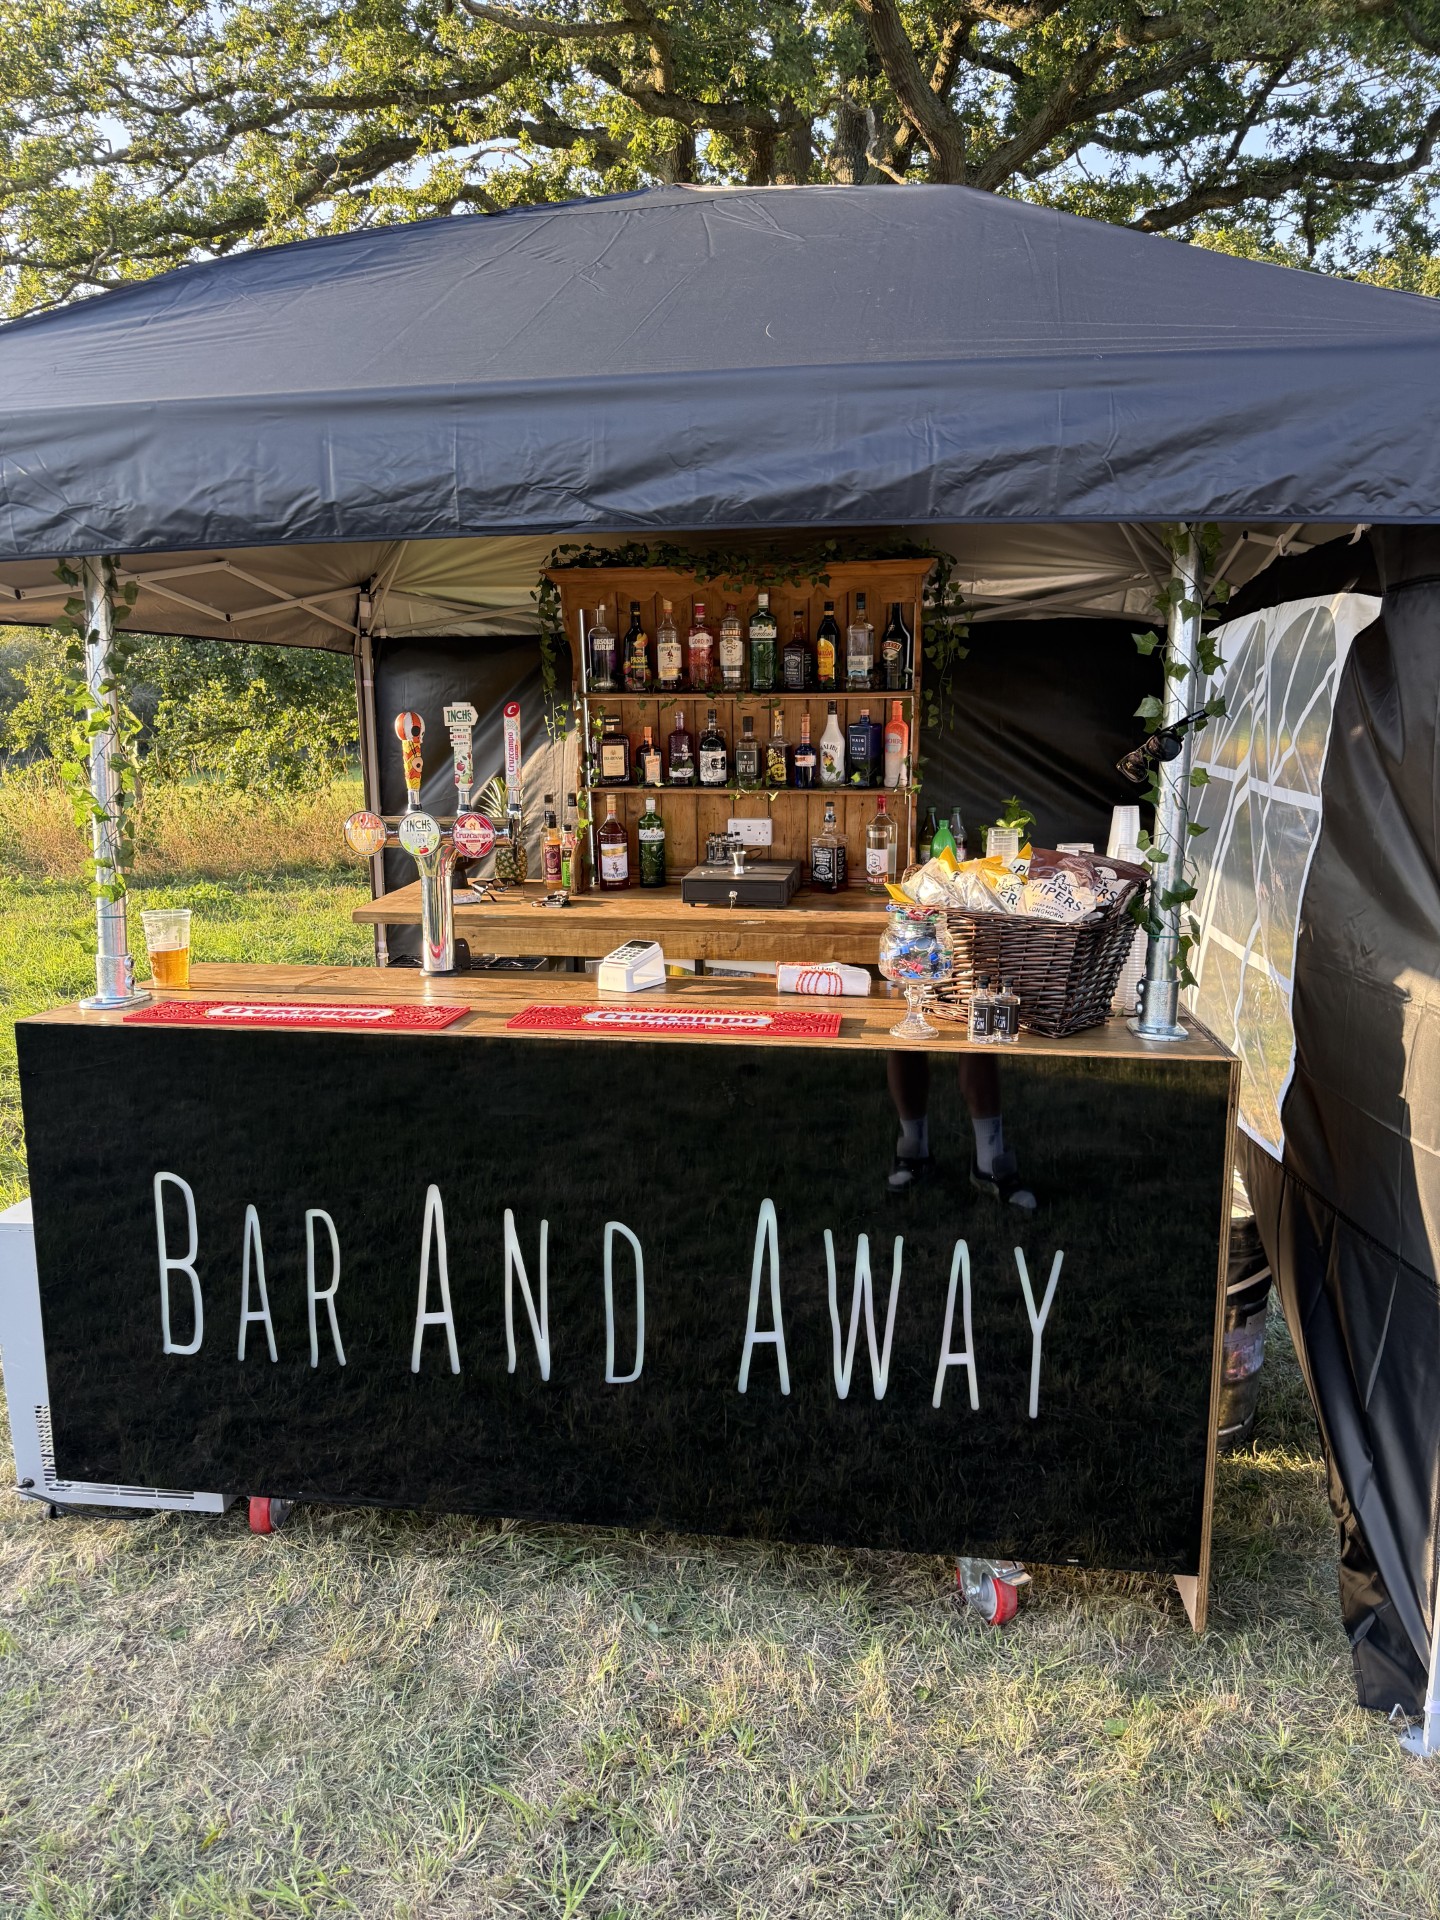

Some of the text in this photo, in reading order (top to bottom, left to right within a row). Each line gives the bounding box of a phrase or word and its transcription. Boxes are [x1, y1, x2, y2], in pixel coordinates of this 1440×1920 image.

[446, 709, 472, 723] INCH'S
[405, 819, 432, 833] INCH'S
[455, 831, 492, 840] Cruzcampo
[1030, 883, 1083, 913] PIPERS
[1028, 905, 1065, 919] LONGHORN
[221, 1006, 383, 1018] Cruzcampo
[597, 1012, 760, 1025] Cruzcampo
[155, 1171, 1064, 1419] BAR AND AWAY
